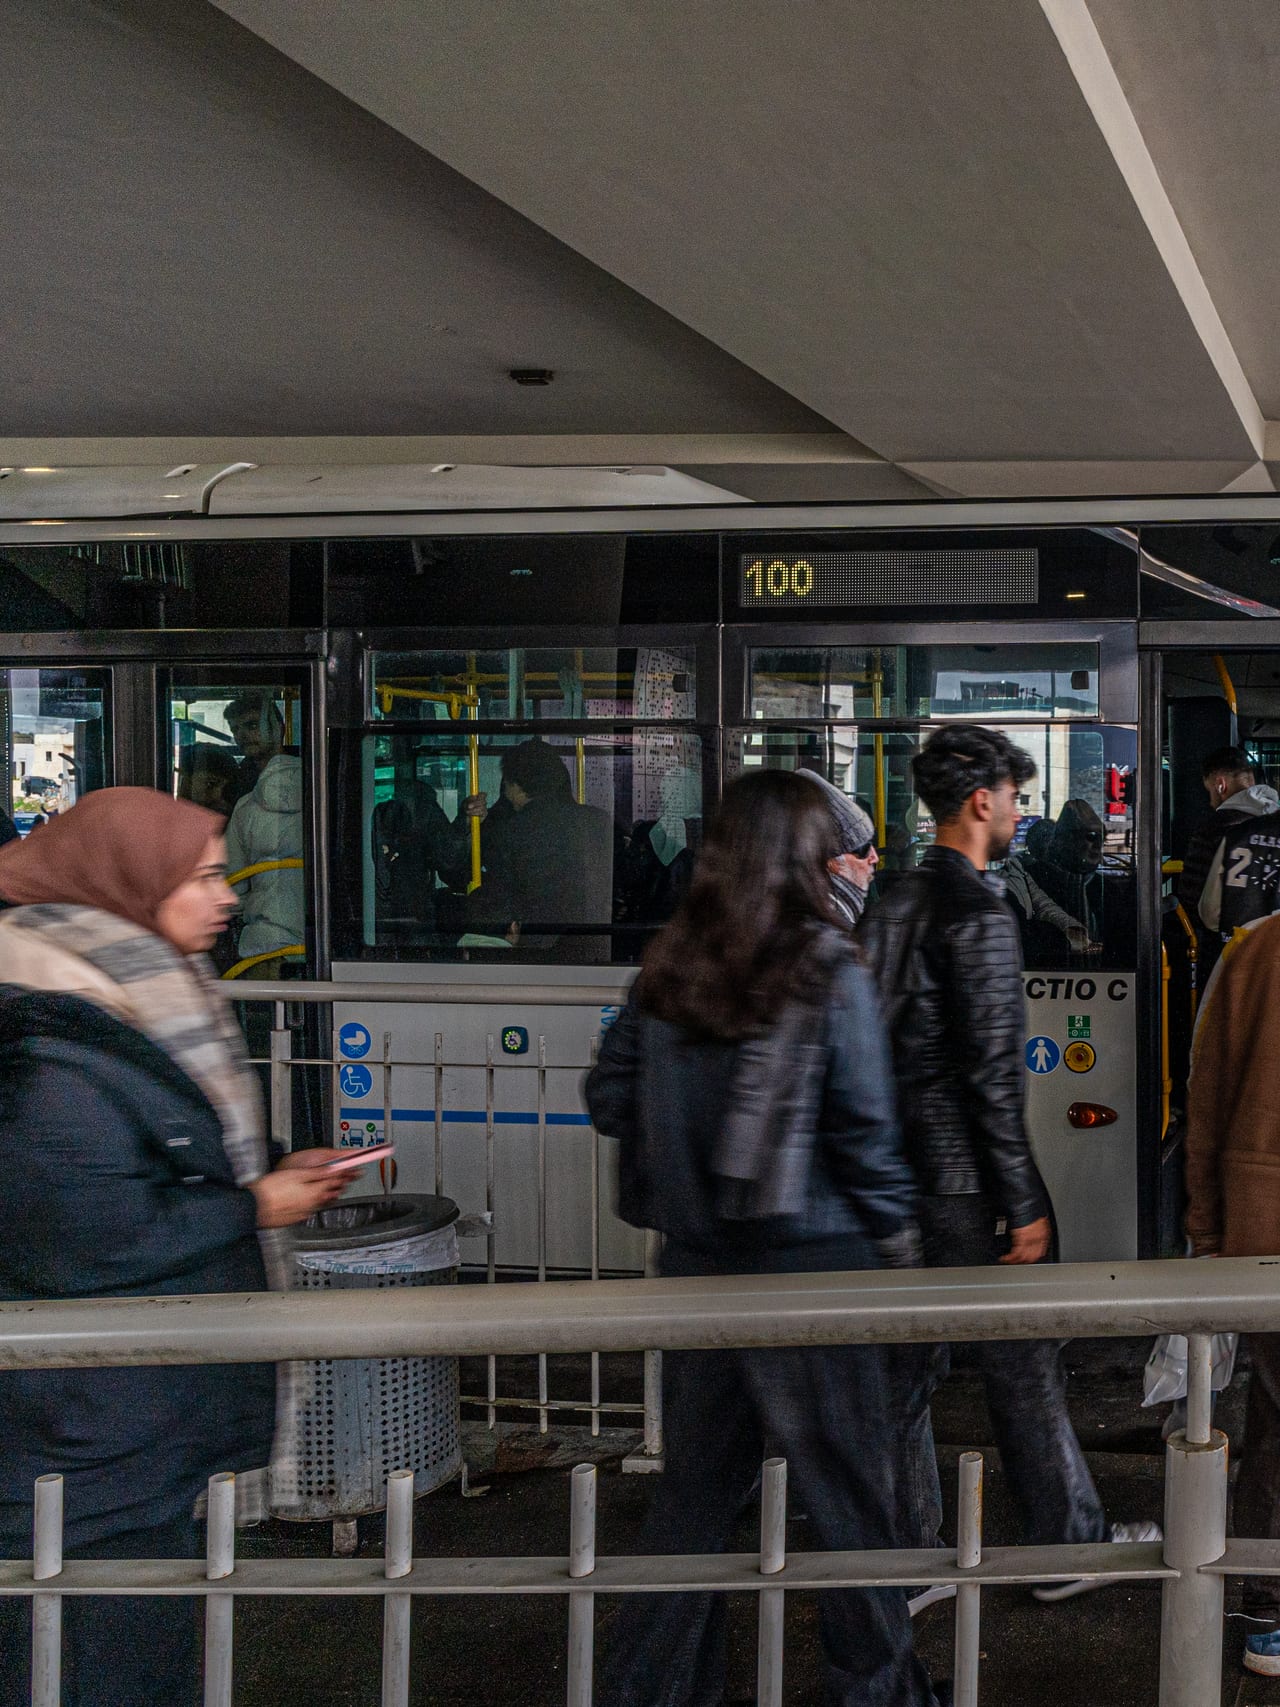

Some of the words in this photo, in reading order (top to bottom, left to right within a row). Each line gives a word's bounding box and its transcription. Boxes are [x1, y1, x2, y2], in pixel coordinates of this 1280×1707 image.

[746, 560, 813, 596] 100
[1021, 977, 1097, 1001] CTIO
[1107, 978, 1129, 1001] C
